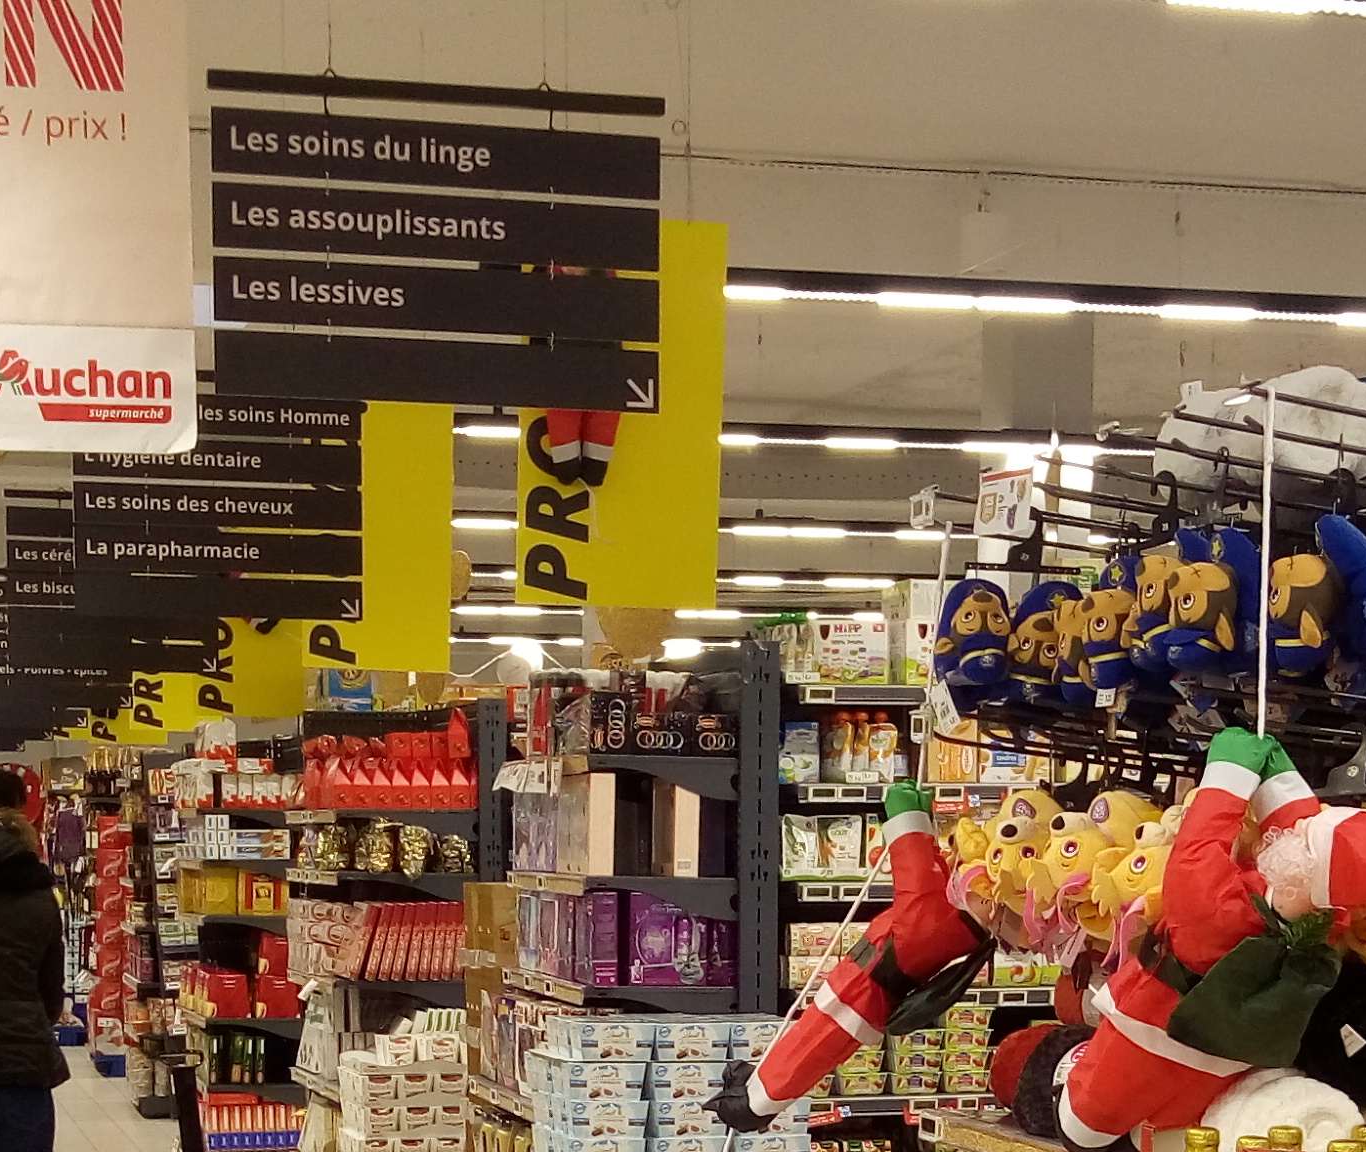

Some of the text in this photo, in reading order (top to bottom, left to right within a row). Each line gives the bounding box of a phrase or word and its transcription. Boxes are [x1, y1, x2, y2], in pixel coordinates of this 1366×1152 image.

[20, 109, 32, 134] /
[45, 111, 108, 146] prix
[229, 125, 492, 173] Les soins du linge
[230, 200, 507, 241] Les assouplissants
[232, 274, 405, 308] Les lessives
[88, 406, 165, 421] supermarché
[228, 407, 275, 426] soins
[279, 408, 351, 428] Homme
[180, 449, 262, 471] dentaire
[84, 491, 294, 516] Les soins des cheveux
[15, 547, 39, 562] Les
[85, 539, 261, 564] La parapharmacie
[15, 580, 39, 593] Les
